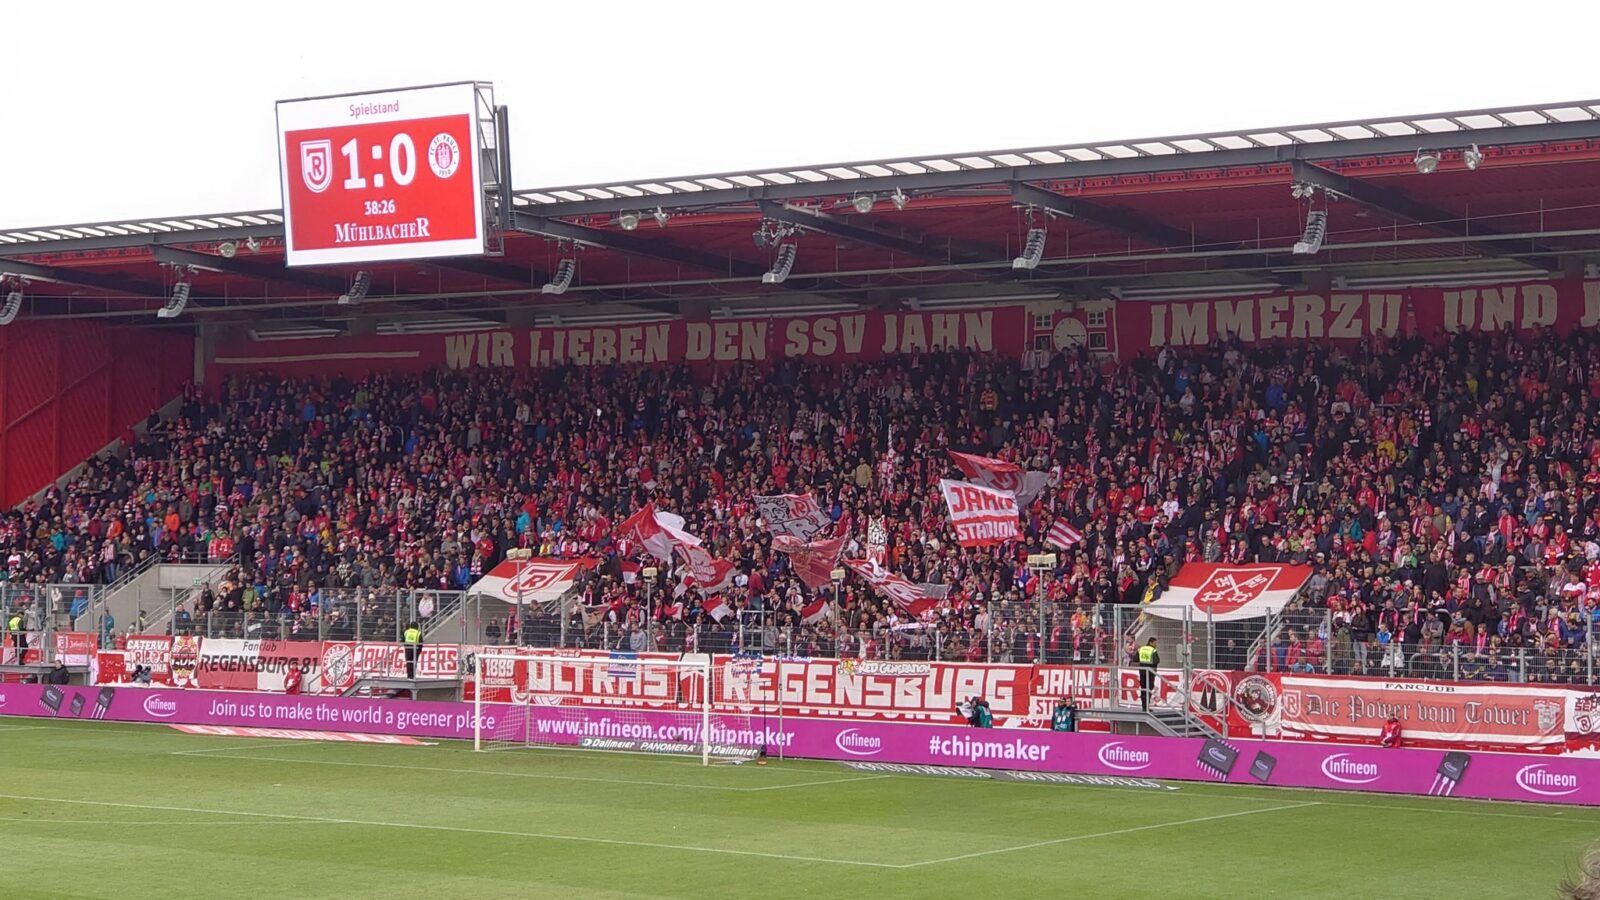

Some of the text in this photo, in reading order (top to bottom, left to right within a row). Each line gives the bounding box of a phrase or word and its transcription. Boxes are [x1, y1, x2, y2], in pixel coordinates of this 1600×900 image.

[349, 100, 400, 118] Spielstand
[341, 132, 416, 189] 1:0
[364, 200, 396, 215] 38:26
[445, 331, 515, 370] WIR
[530, 324, 670, 368] LIEBEN
[686, 322, 768, 362] DEN
[785, 314, 866, 357] SSV
[882, 311, 993, 354] JAHN
[1150, 294, 1401, 347] IMMERZU
[1443, 284, 1558, 333] UND
[957, 520, 1018, 541] STADION
[242, 641, 277, 652] Fanclub
[300, 657, 319, 675] 81
[529, 655, 668, 697] ULTRAS
[723, 661, 1015, 711] REGENSBURG
[1036, 668, 1092, 696] JAHN
[1385, 683, 1455, 692] FANCLUB
[208, 699, 495, 732] Join us to make the world a greener place
[1306, 694, 1530, 725] Die Power vom Tower
[592, 738, 694, 753] Dallmeier PANOMERA
[712, 744, 758, 757] Dallmeier
[929, 735, 1050, 761] #chipmaker
